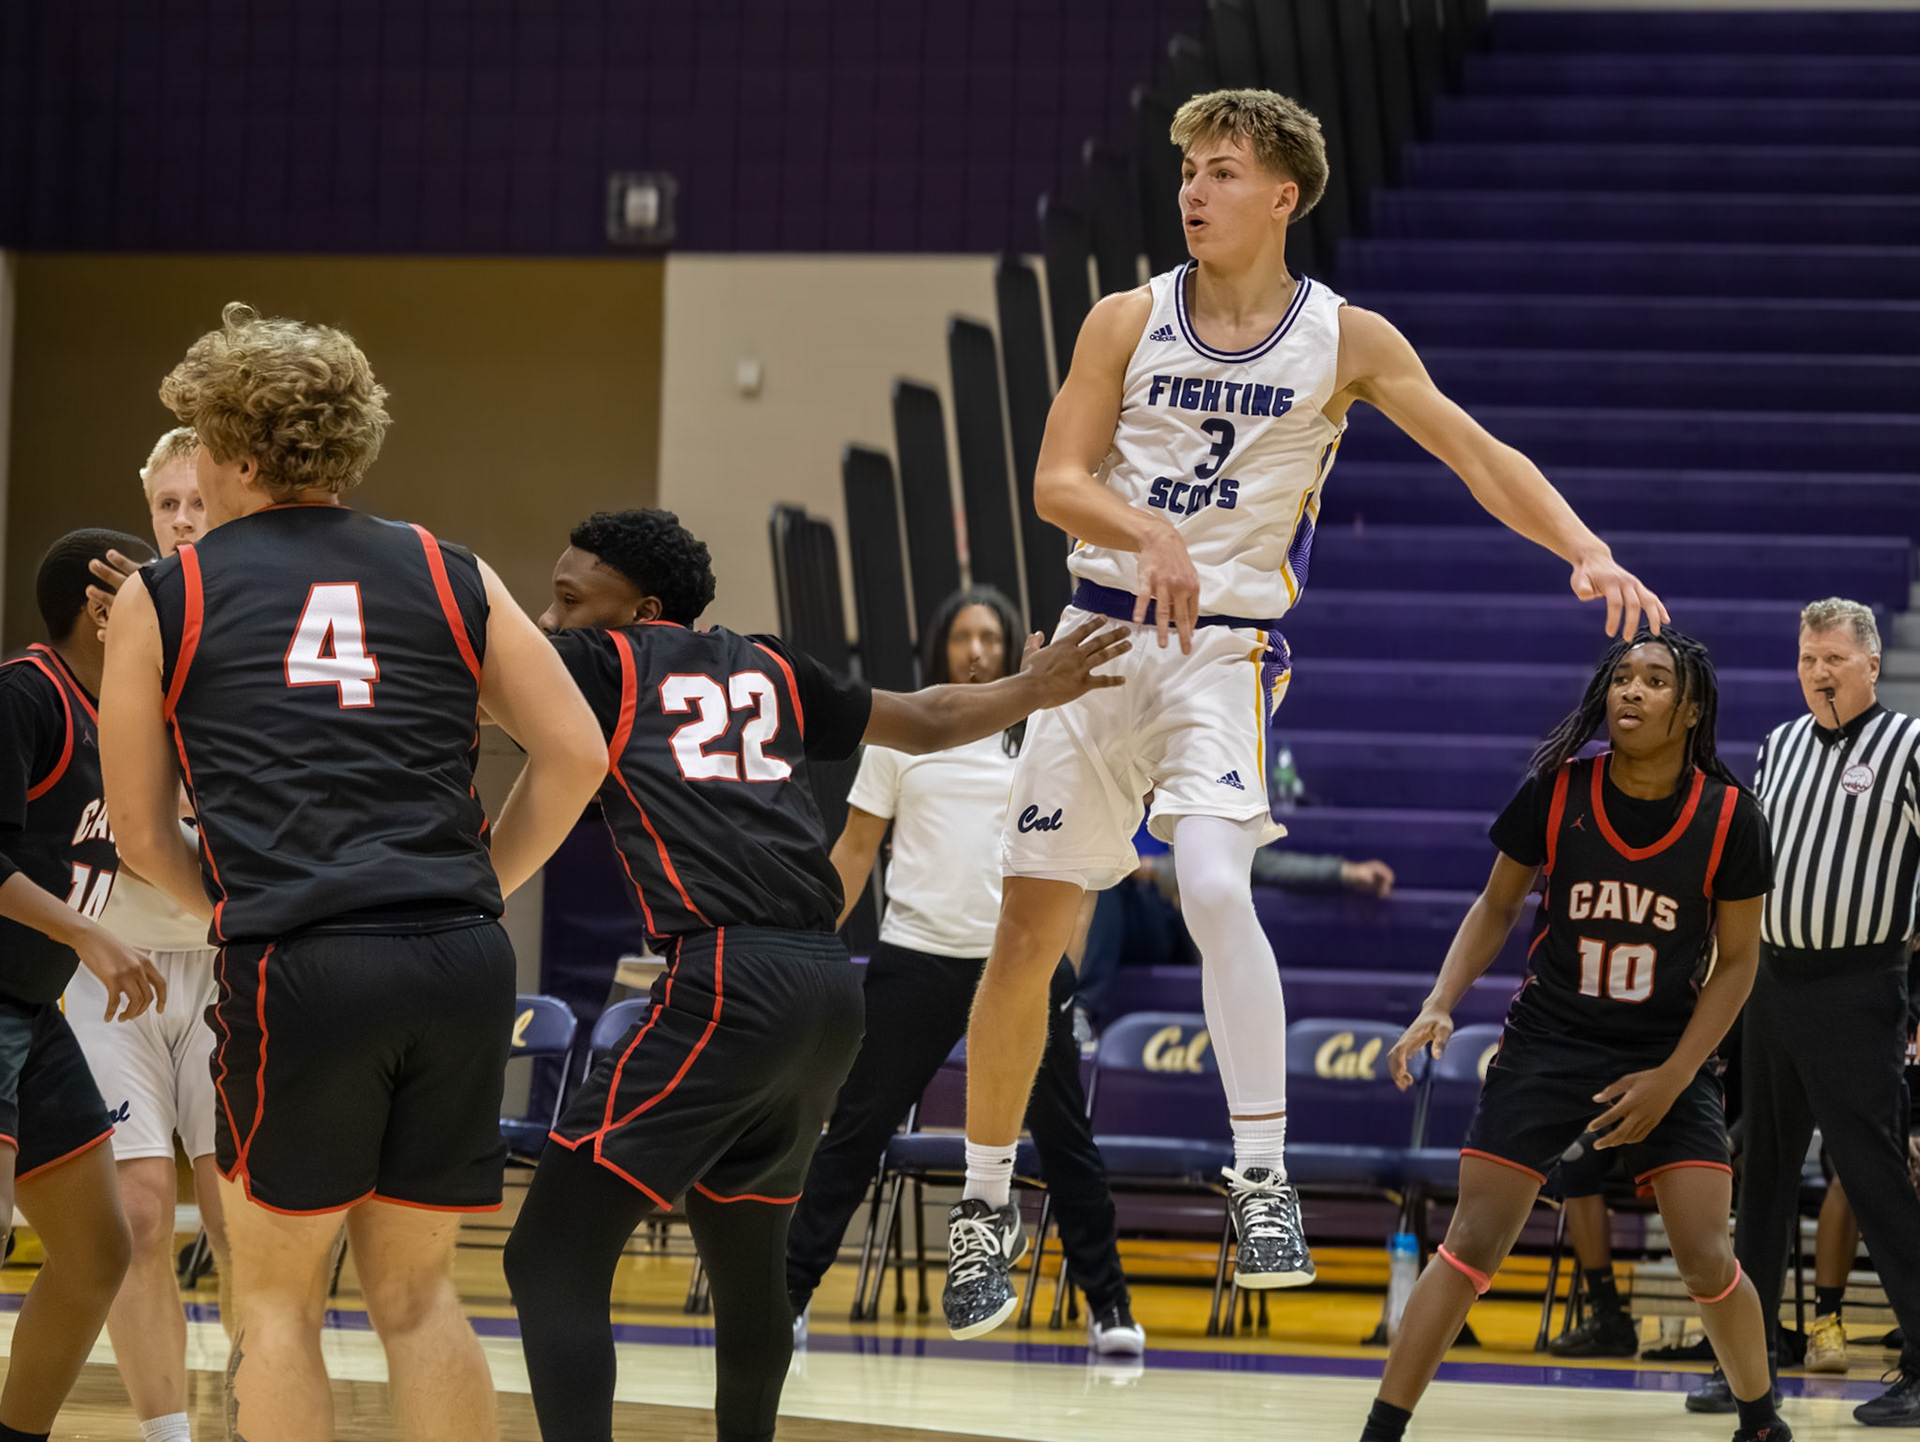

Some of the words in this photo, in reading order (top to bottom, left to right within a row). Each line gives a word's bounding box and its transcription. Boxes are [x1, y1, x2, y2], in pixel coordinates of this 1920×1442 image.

[1148, 375, 1295, 417] FIGHTING
[1194, 418, 1236, 480] 3
[284, 581, 380, 710] 4
[658, 670, 793, 783] 22
[72, 798, 121, 858] CA
[1018, 804, 1063, 833] Cal
[1568, 880, 1679, 932] CAVS
[1578, 936, 1657, 1004] 10
[1142, 1026, 1209, 1073] Cal
[1314, 1032, 1382, 1079] Cal
[108, 1100, 130, 1123] al
